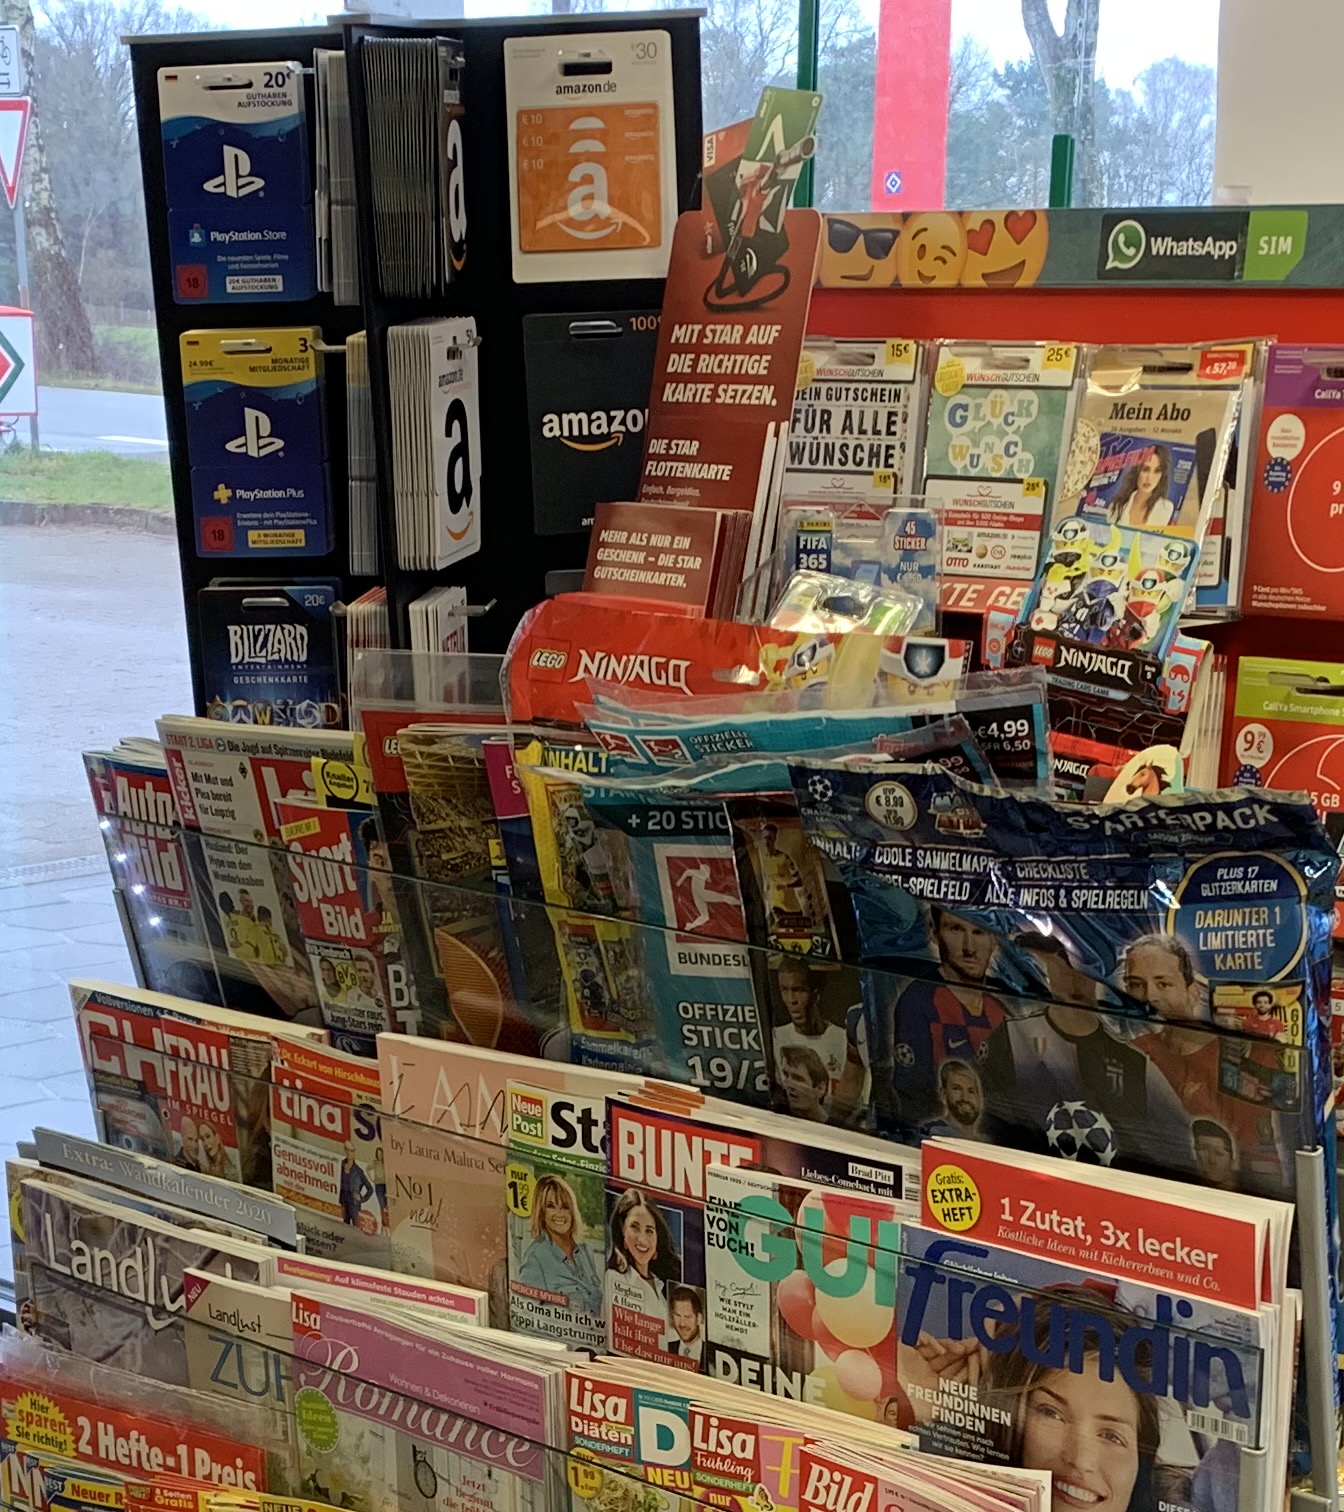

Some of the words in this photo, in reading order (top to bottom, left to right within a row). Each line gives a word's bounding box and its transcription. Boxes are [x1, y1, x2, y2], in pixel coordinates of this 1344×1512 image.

[556, 81, 616, 96] amazon.de
[1151, 236, 1237, 258] WhatsApp
[1259, 236, 1292, 255] SIM
[672, 324, 699, 343] MIT
[705, 325, 741, 343] STAR
[747, 324, 780, 345] AUF
[668, 354, 694, 374] DIE
[700, 353, 769, 376] RICHTIGE
[663, 383, 710, 403] KARTE
[716, 384, 778, 406] SETZEN.
[542, 409, 648, 439] amazo
[792, 406, 831, 435] FÜR
[842, 410, 897, 436] ALLE
[1109, 402, 1151, 422] Mein
[1156, 403, 1191, 422] Abo
[790, 437, 895, 468] WÜNSCHE
[646, 462, 732, 481] FLOTTENKARTE
[1333, 480, 1344, 497] 9
[800, 536, 828, 550] FIFA
[800, 553, 827, 569] 365
[594, 568, 687, 588] GUTSCHEINKARTEN.
[227, 625, 308, 665] BLIZZARD
[233, 675, 308, 685] GESCHENKKARTE
[531, 650, 567, 670] LEGO
[576, 649, 691, 688] NINJAGO
[320, 905, 364, 941] Bild
[1195, 907, 1268, 928] DARUNTER
[1200, 929, 1275, 950] LIMITIERTE
[1215, 951, 1262, 971] KARTE
[160, 1027, 232, 1112] FRAU
[278, 1081, 344, 1135] tina
[512, 1094, 543, 1117] Neue
[512, 1114, 545, 1138] Post
[274, 1143, 336, 1175] Genussvoll
[618, 1116, 755, 1200] BUNTE
[63, 1145, 114, 1174] Extra:
[119, 1160, 231, 1208] Wandkalender
[236, 1198, 273, 1228] 2020
[276, 1161, 339, 1195] abnehmen
[851, 1163, 870, 1178] Brad
[873, 1167, 892, 1183] Pitt
[935, 1172, 965, 1188] Gratis:
[931, 1188, 976, 1206] EXTRA-
[941, 1203, 974, 1223] HEFT
[706, 1233, 756, 1259] EUCH!
[1000, 1198, 1013, 1221] 1
[1020, 1201, 1093, 1246] Zutat,
[1100, 1220, 1130, 1251] 3x
[1137, 1226, 1218, 1271] lecker
[997, 1225, 1042, 1250] Köstliche
[1046, 1238, 1076, 1259] Ideen
[1079, 1246, 1098, 1263] mit
[1101, 1249, 1174, 1281] Kichererbsen
[1177, 1268, 1199, 1286] und
[208, 1302, 262, 1335] Landlust
[292, 1300, 321, 1332] Lisa
[901, 1240, 1251, 1420] freundin
[301, 1331, 537, 1468] Romance
[569, 1378, 628, 1420] Lisa
[939, 1378, 978, 1399] NEUE
[907, 1383, 1011, 1427] FREUNDINNEN
[18, 1408, 68, 1435] sparen
[571, 1414, 632, 1444] Diäten
[932, 1407, 986, 1434] FINDEN
[693, 1412, 755, 1459] Lisa
[694, 1452, 755, 1483] Frühling
